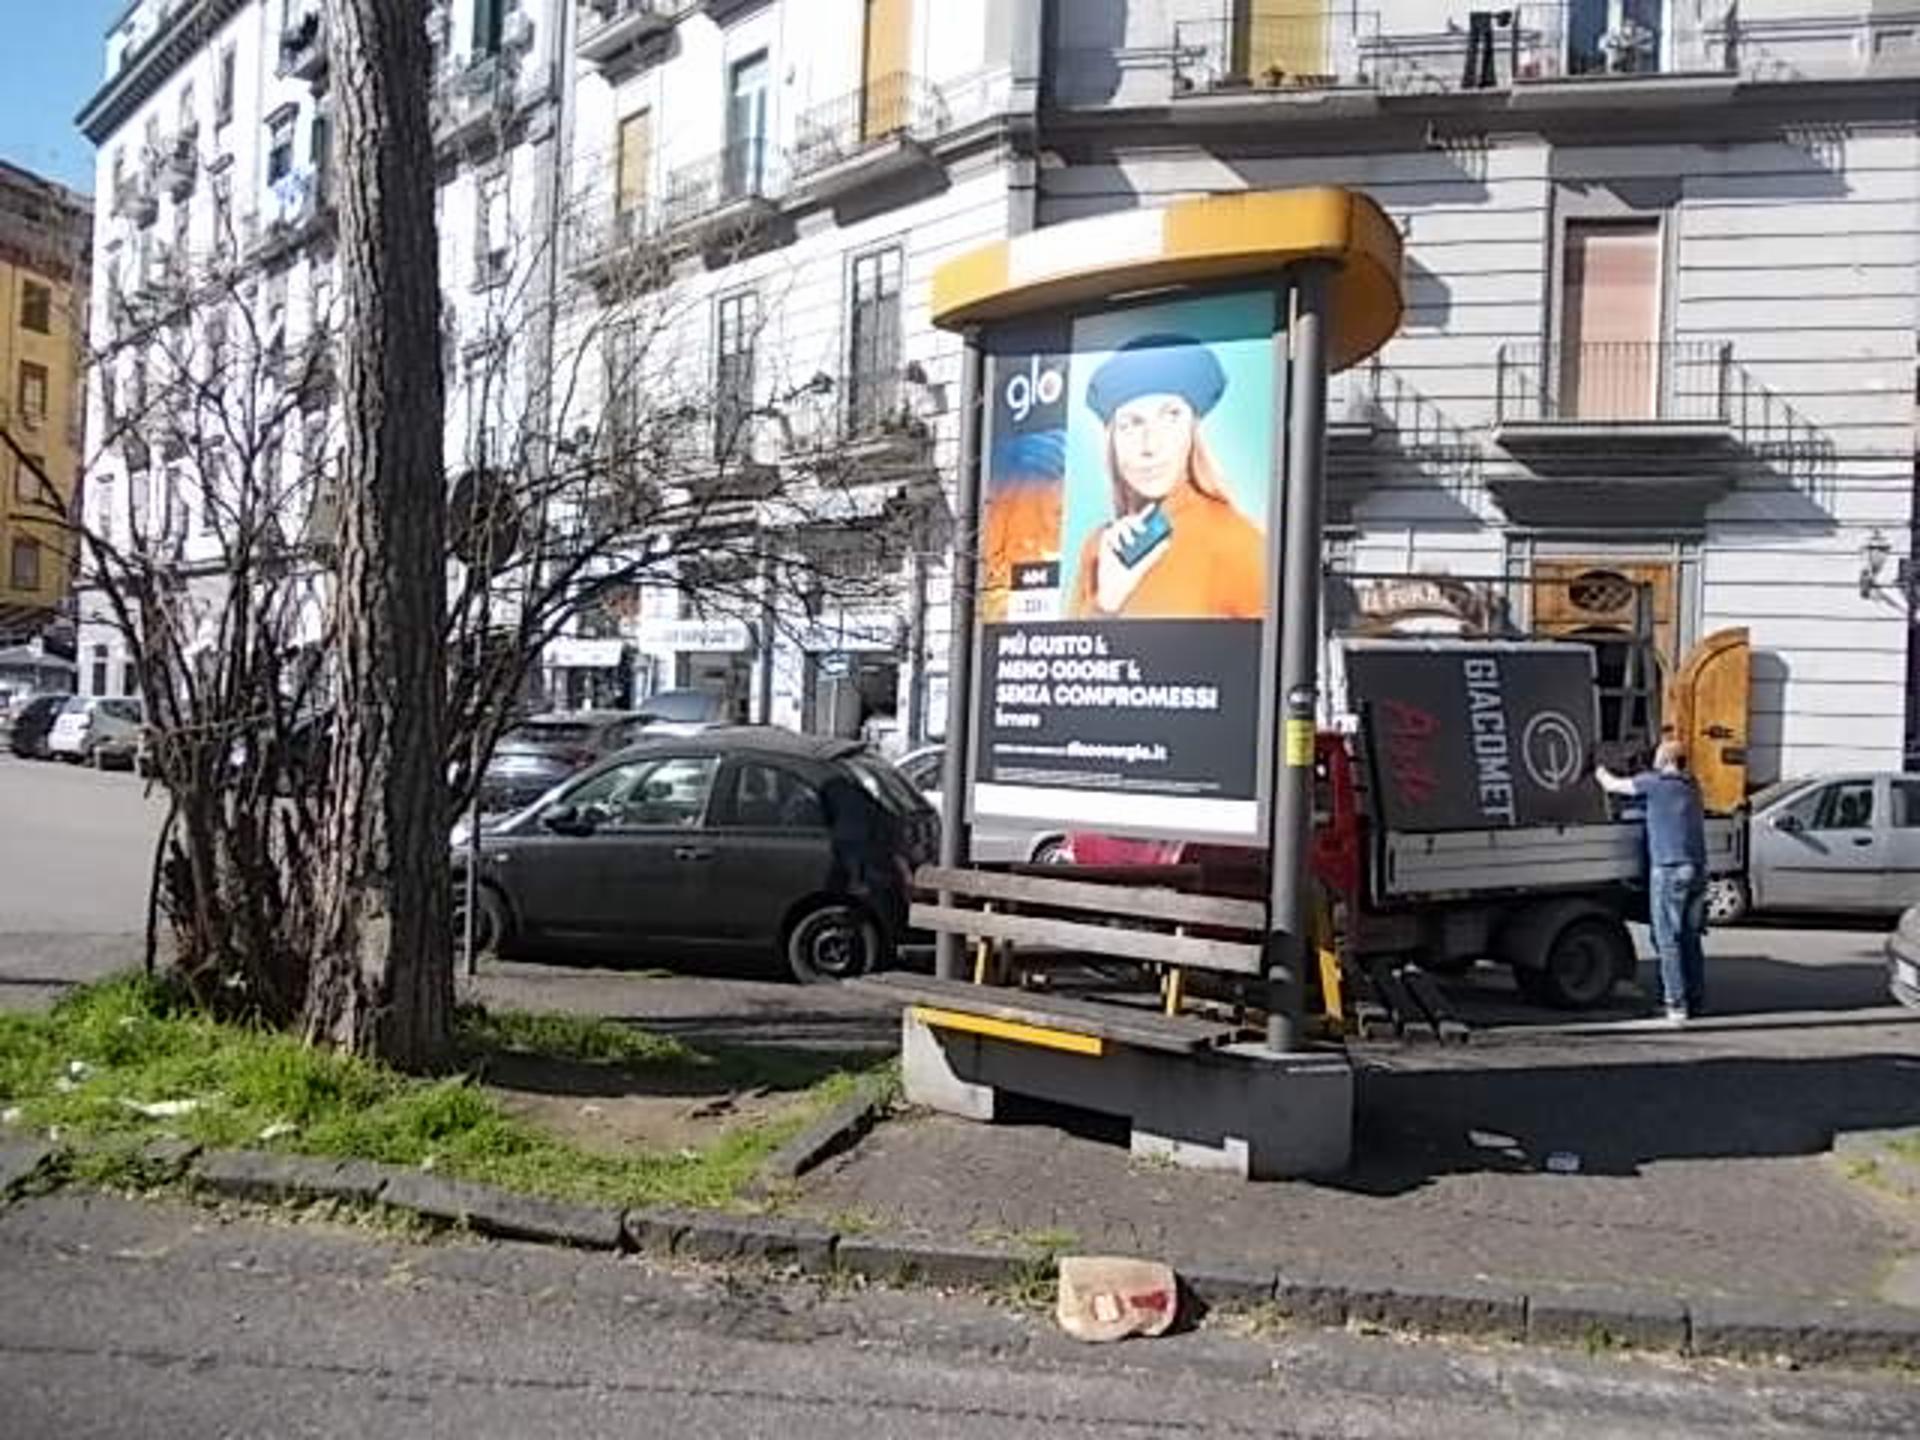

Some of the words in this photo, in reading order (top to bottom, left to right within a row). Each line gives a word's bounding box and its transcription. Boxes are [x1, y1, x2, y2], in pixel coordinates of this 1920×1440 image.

[1007, 355, 1063, 421] glo
[1028, 635, 1093, 656] GUSTO
[998, 659, 1049, 680] MENO
[996, 683, 1051, 705] SENZA
[1054, 684, 1219, 709] COMPROMESSI
[1463, 658, 1516, 826] GIACOMET
